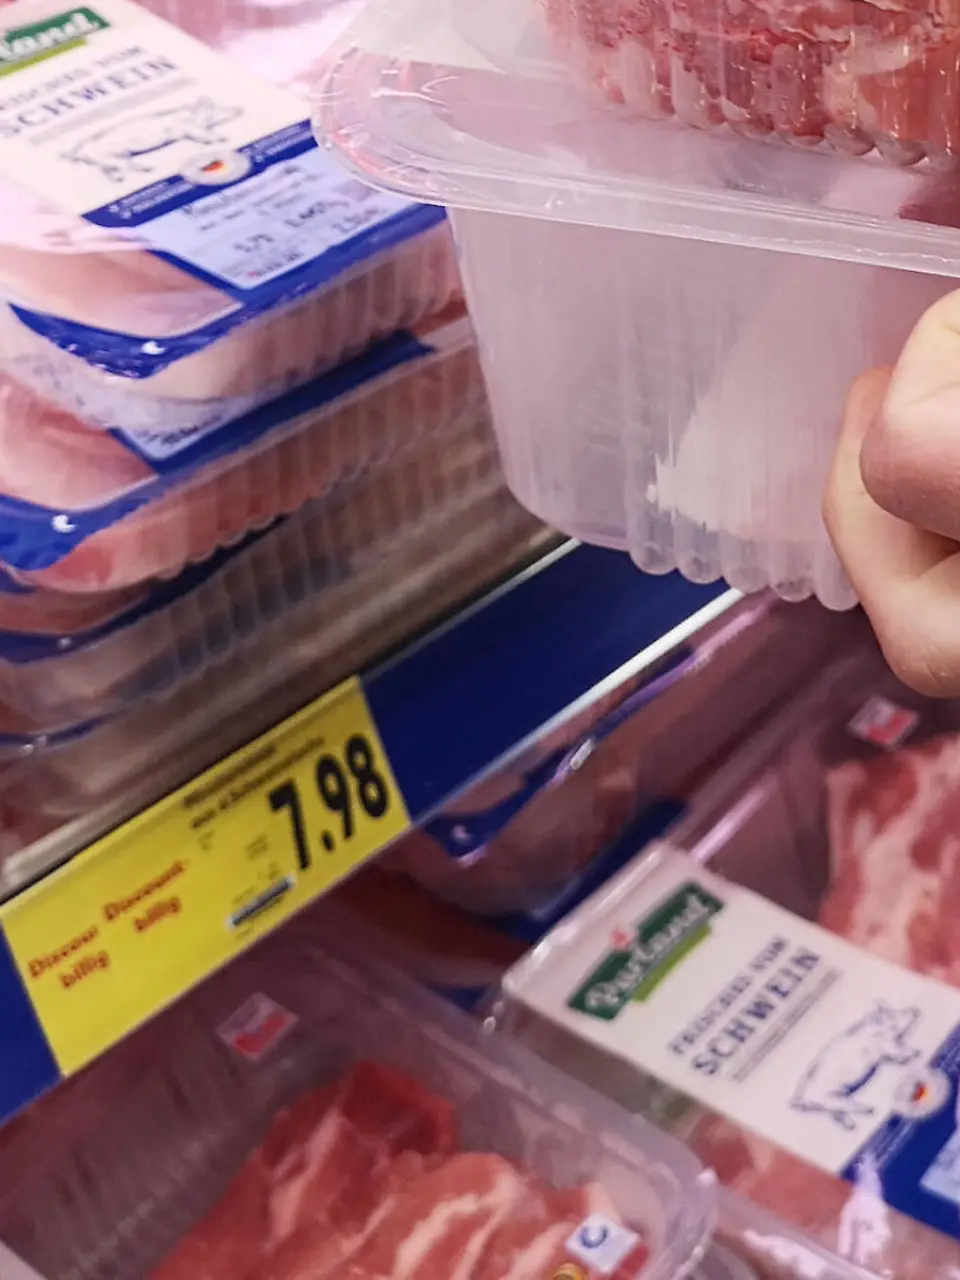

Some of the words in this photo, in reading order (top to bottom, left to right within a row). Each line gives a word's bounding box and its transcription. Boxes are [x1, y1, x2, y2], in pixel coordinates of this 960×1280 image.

[268, 733, 389, 871] 7.98
[134, 896, 181, 933] billig
[61, 951, 110, 989] billig
[692, 944, 822, 1076] SCHWEIN
